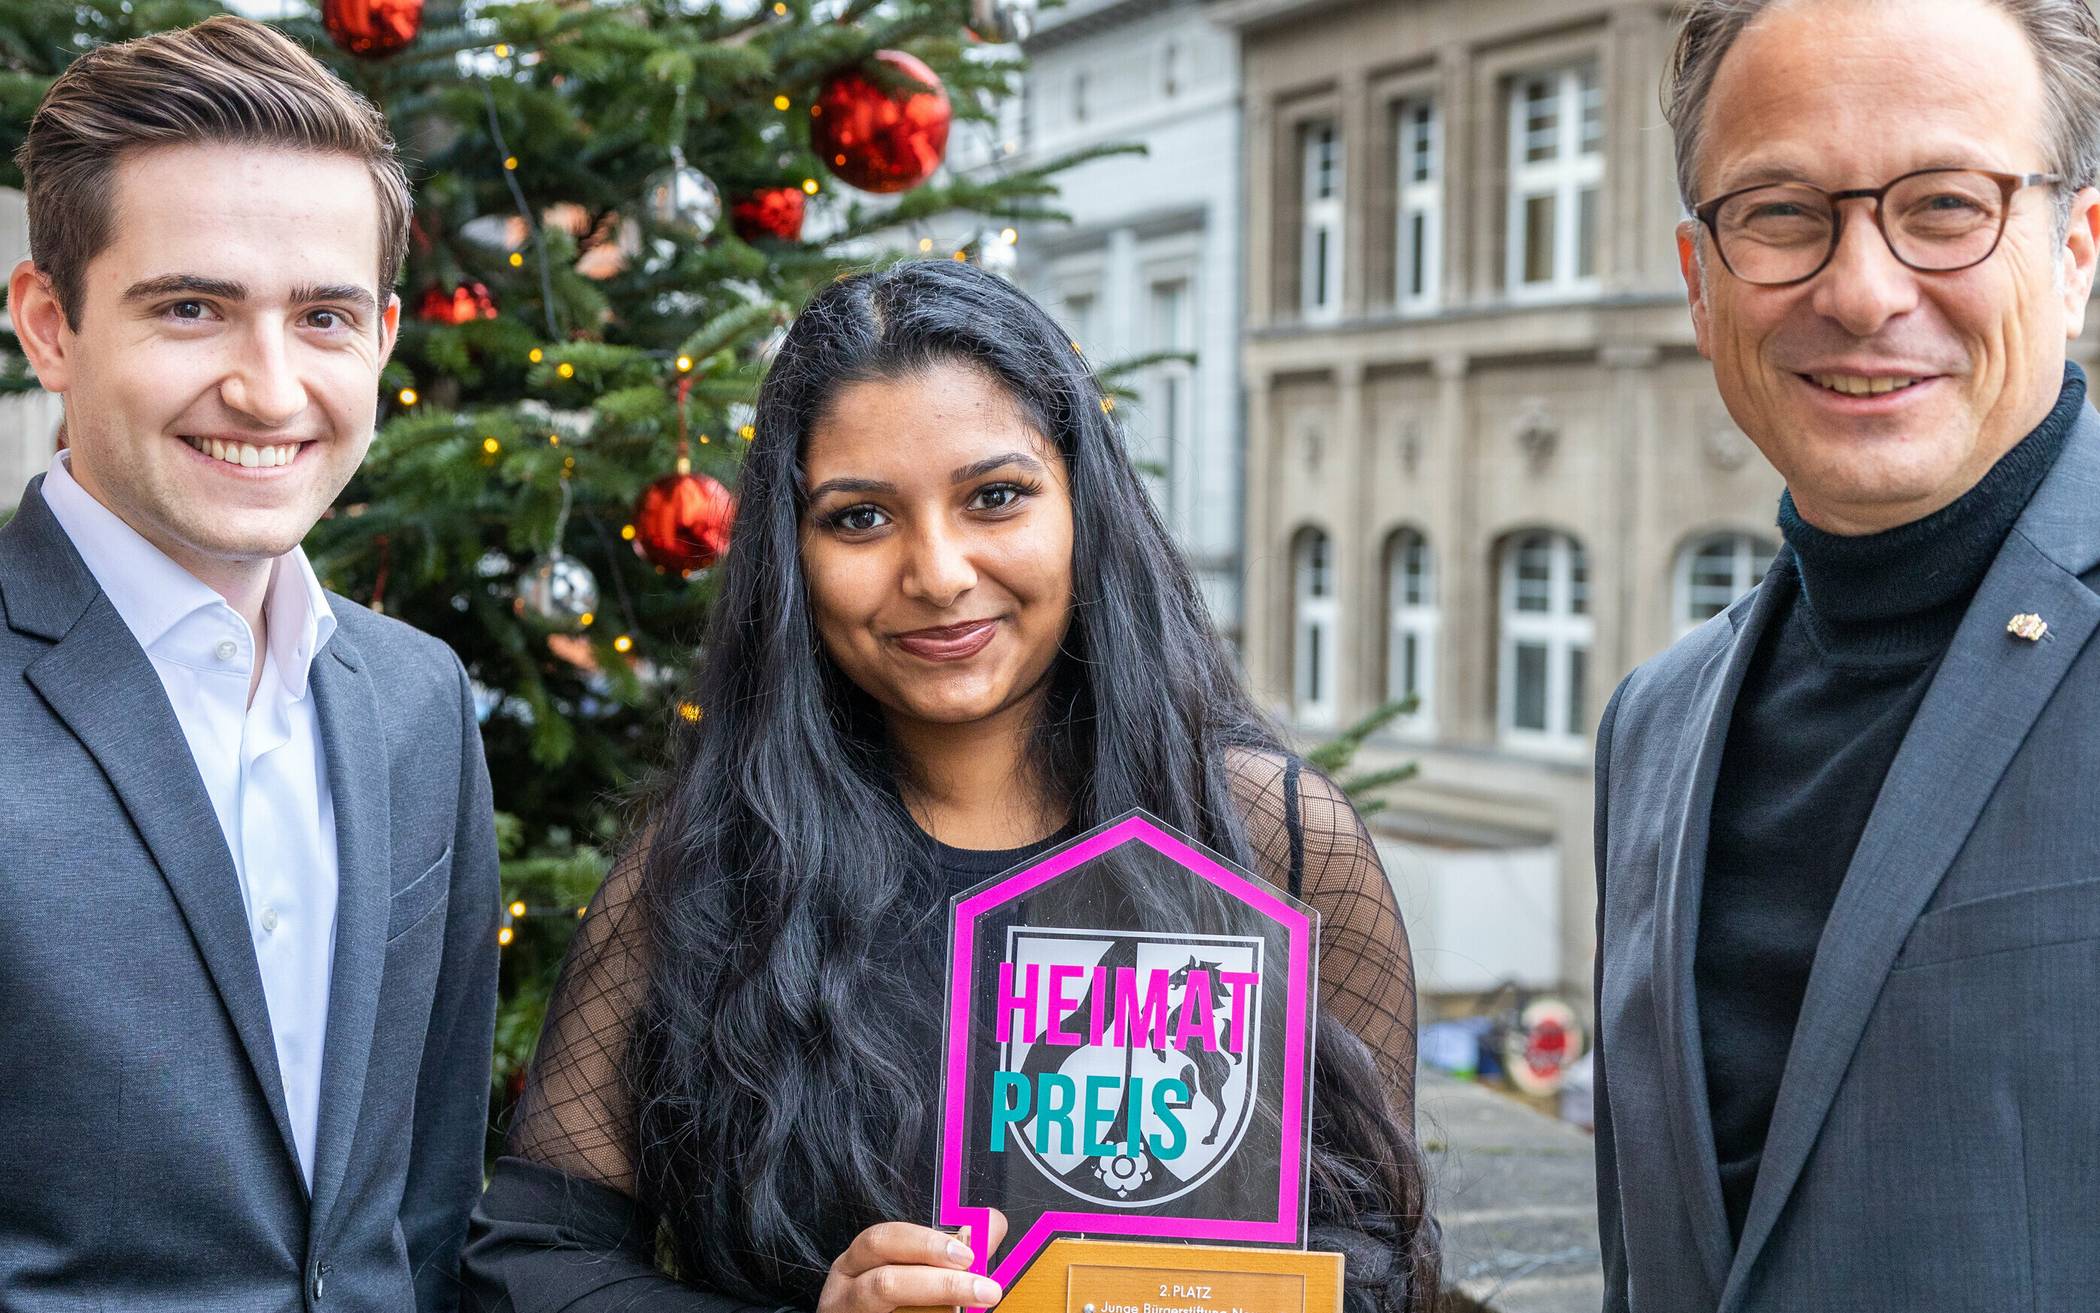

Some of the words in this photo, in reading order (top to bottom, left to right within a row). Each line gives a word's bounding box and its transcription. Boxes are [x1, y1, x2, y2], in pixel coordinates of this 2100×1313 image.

[996, 962, 1260, 1053] HEIMAT
[990, 1071, 1190, 1160] PREIS
[1143, 1303, 1227, 1313] Bürgerstift
[1159, 1284, 1171, 1297] 2.
[1173, 1285, 1212, 1299] PLATZ
